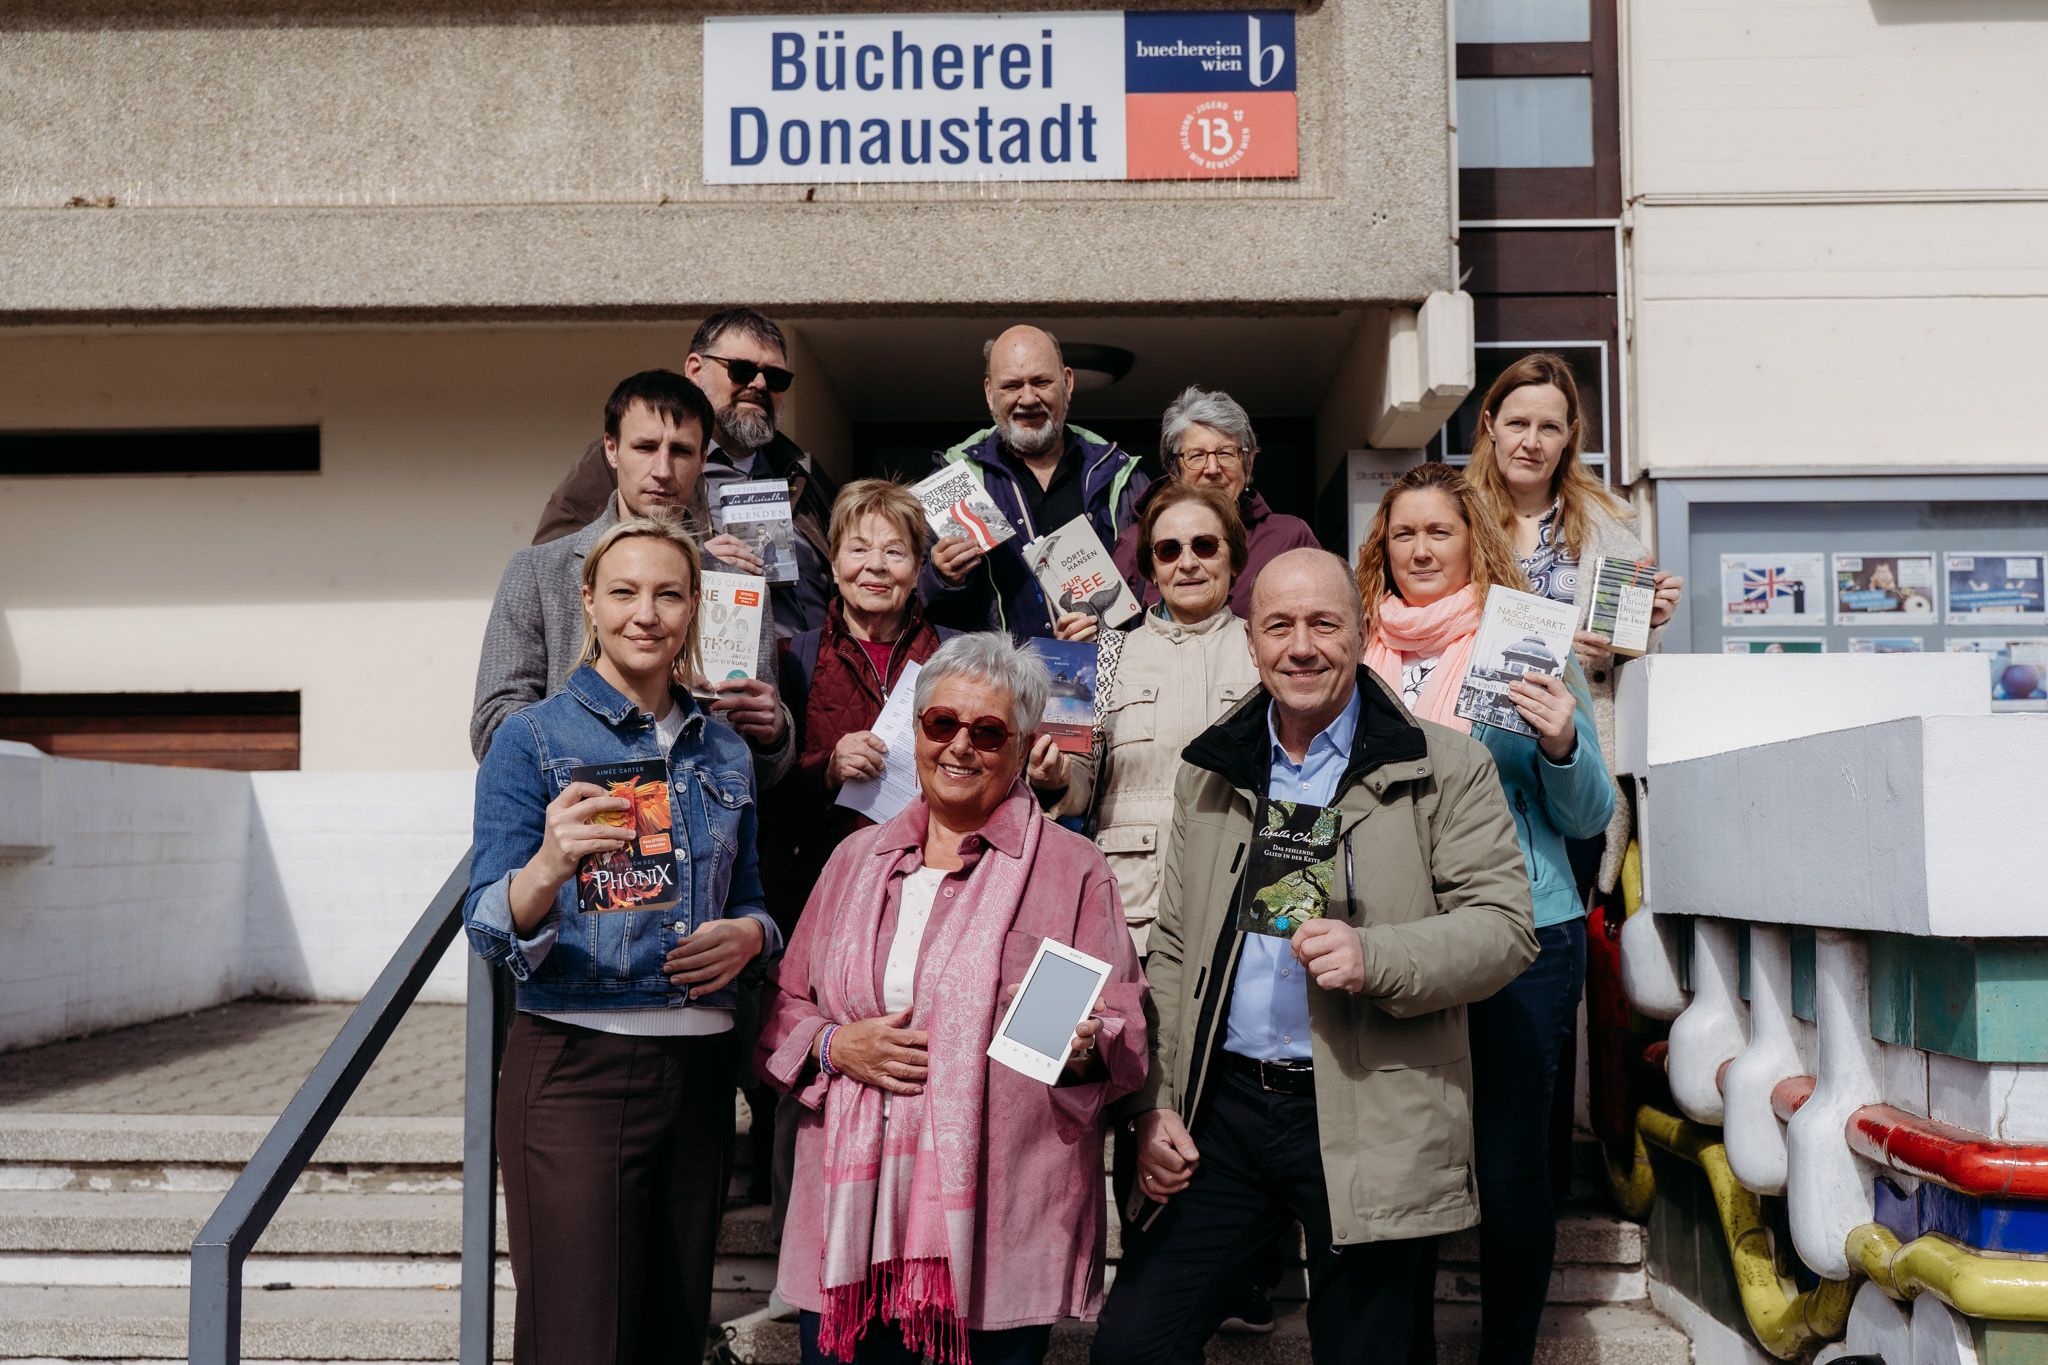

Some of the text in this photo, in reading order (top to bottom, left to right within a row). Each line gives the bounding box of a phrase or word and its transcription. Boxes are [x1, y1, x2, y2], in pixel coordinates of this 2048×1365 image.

[1136, 40, 1242, 57] buechereien
[771, 29, 1053, 91] Bücherei
[1202, 57, 1242, 71] wien
[730, 103, 1098, 166] Donaustadt
[1180, 101, 1228, 150] BILDUNG JUGEND
[1198, 118, 1233, 155] 13
[729, 494, 745, 505] Les
[927, 480, 971, 508] POLITISCHE
[929, 485, 978, 517] LANDSCHAFT
[731, 509, 787, 521] ELENDEN
[1060, 549, 1086, 568] DÖRTE
[1067, 550, 1098, 573] HANSEN
[1060, 575, 1082, 592] ZUR
[1071, 572, 1107, 600] SEE
[1516, 602, 1530, 612] DIE
[1619, 604, 1647, 617] Dinner
[1498, 606, 1567, 632] NASCHMARKT-
[1501, 615, 1535, 632] MORDE
[1617, 614, 1630, 624] for
[597, 766, 644, 776] AIMÉE CARTER
[1259, 825, 1331, 846] Agatha Christie
[591, 863, 673, 900] PHÖNIX
